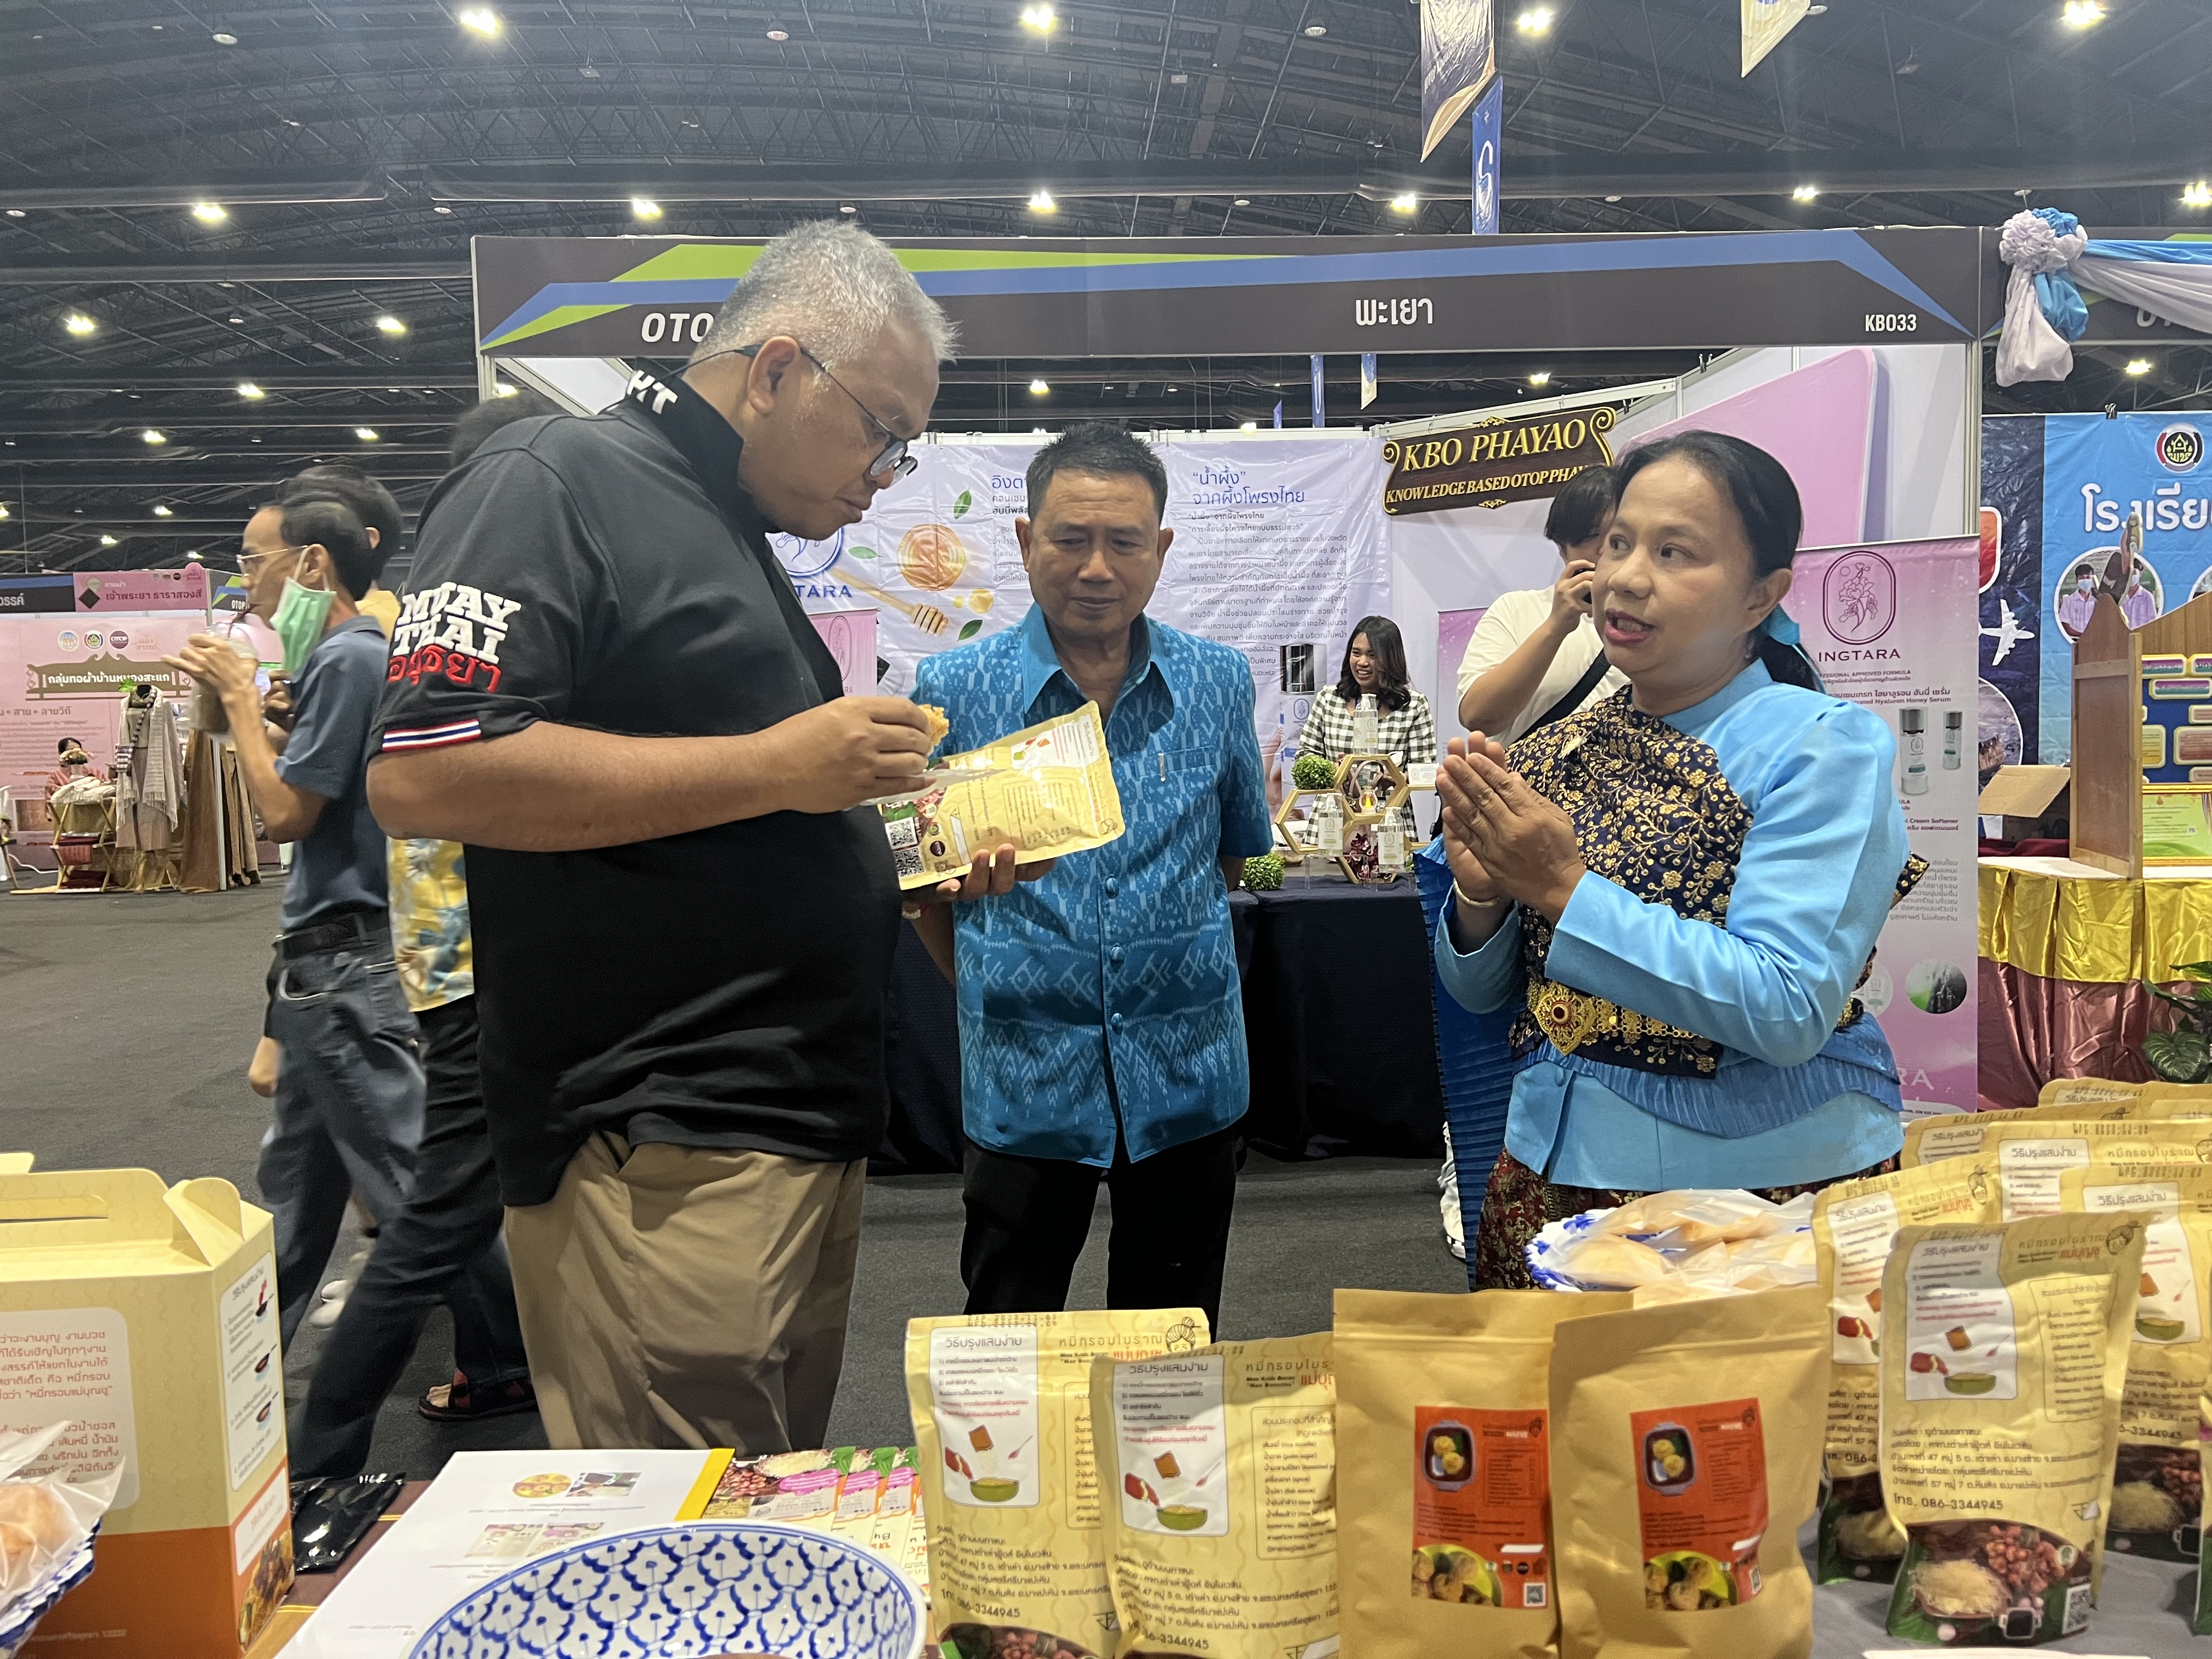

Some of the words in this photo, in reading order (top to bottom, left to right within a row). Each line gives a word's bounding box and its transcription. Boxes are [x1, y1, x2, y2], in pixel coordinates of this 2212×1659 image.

[1356, 298, 1433, 326] พะเยา
[1401, 438, 1463, 472] KBO
[1469, 418, 1587, 463] PHAYAO
[992, 475, 1024, 489] อิงต
[1386, 481, 1466, 503] KNOWLEDGE
[1466, 475, 1510, 493] BASED
[1510, 471, 1549, 487] OTOP
[1193, 486, 1305, 505] จากผึ้งโพรงไทย
[2081, 482, 2212, 533] โรงเรีย
[397, 582, 521, 631] MUAY
[393, 614, 506, 664] THAI
[1818, 648, 1901, 662] INGTARA
[945, 1334, 1022, 1349] วิธีปรุงแสนง่าย
[67, 1370, 110, 1383] หมี่กรอบ
[1931, 1480, 1941, 1488] 57
[1921, 1497, 2004, 1510] 086-3344945
